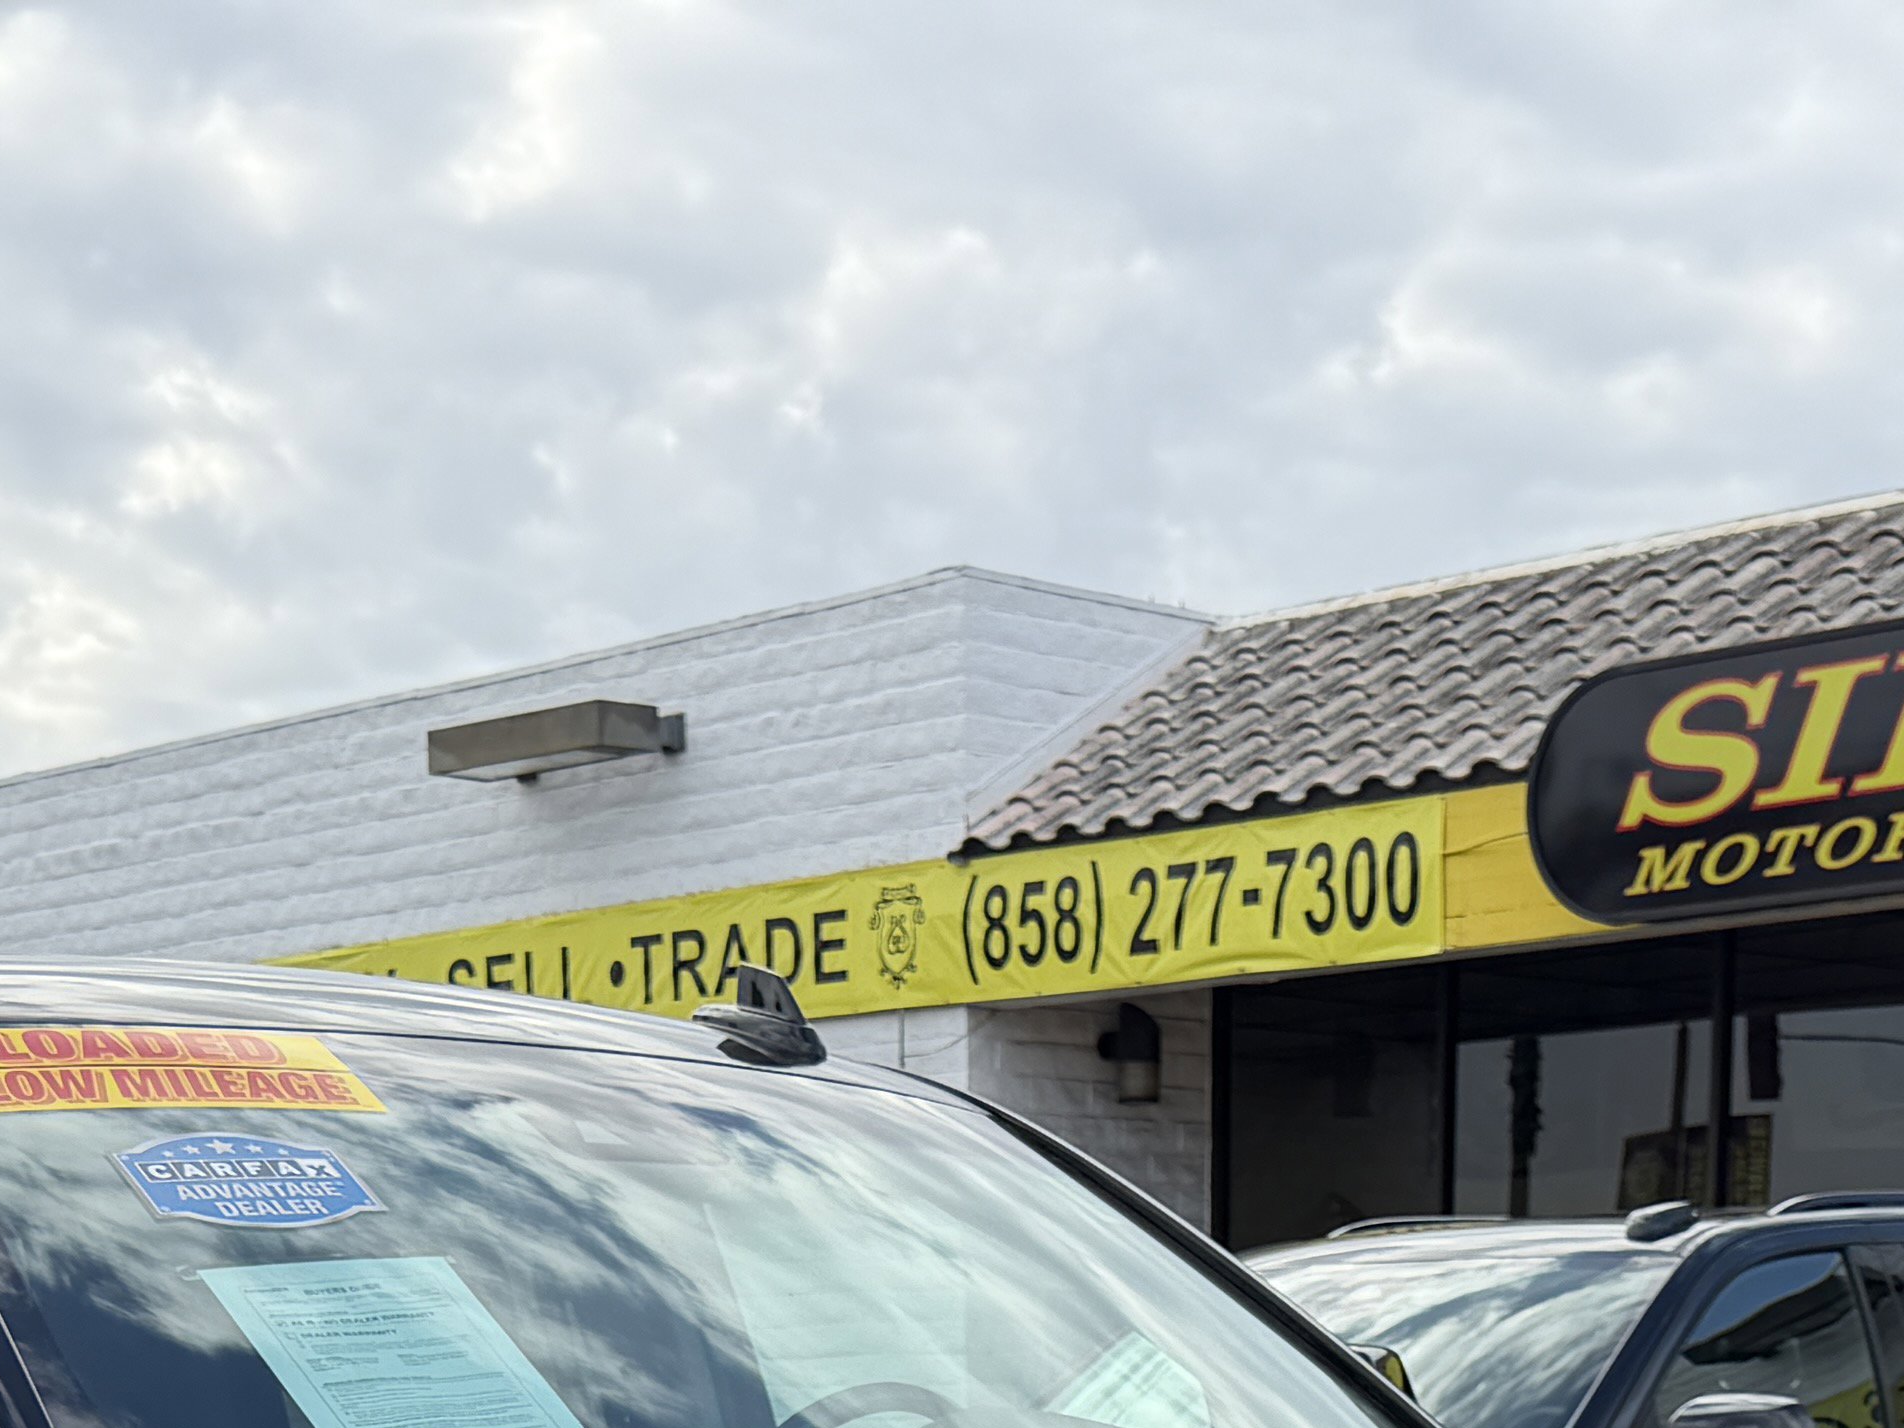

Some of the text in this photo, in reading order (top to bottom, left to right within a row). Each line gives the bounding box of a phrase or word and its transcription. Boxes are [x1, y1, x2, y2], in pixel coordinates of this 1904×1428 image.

[963, 831, 1421, 986] (858) 277-7300
[631, 909, 849, 1004] TRADE
[115, 1069, 360, 1104] MILEAGE
[142, 1158, 336, 1182] CARFAX
[176, 1181, 344, 1200] ADVANTAGE
[215, 1199, 329, 1217] DEALER
